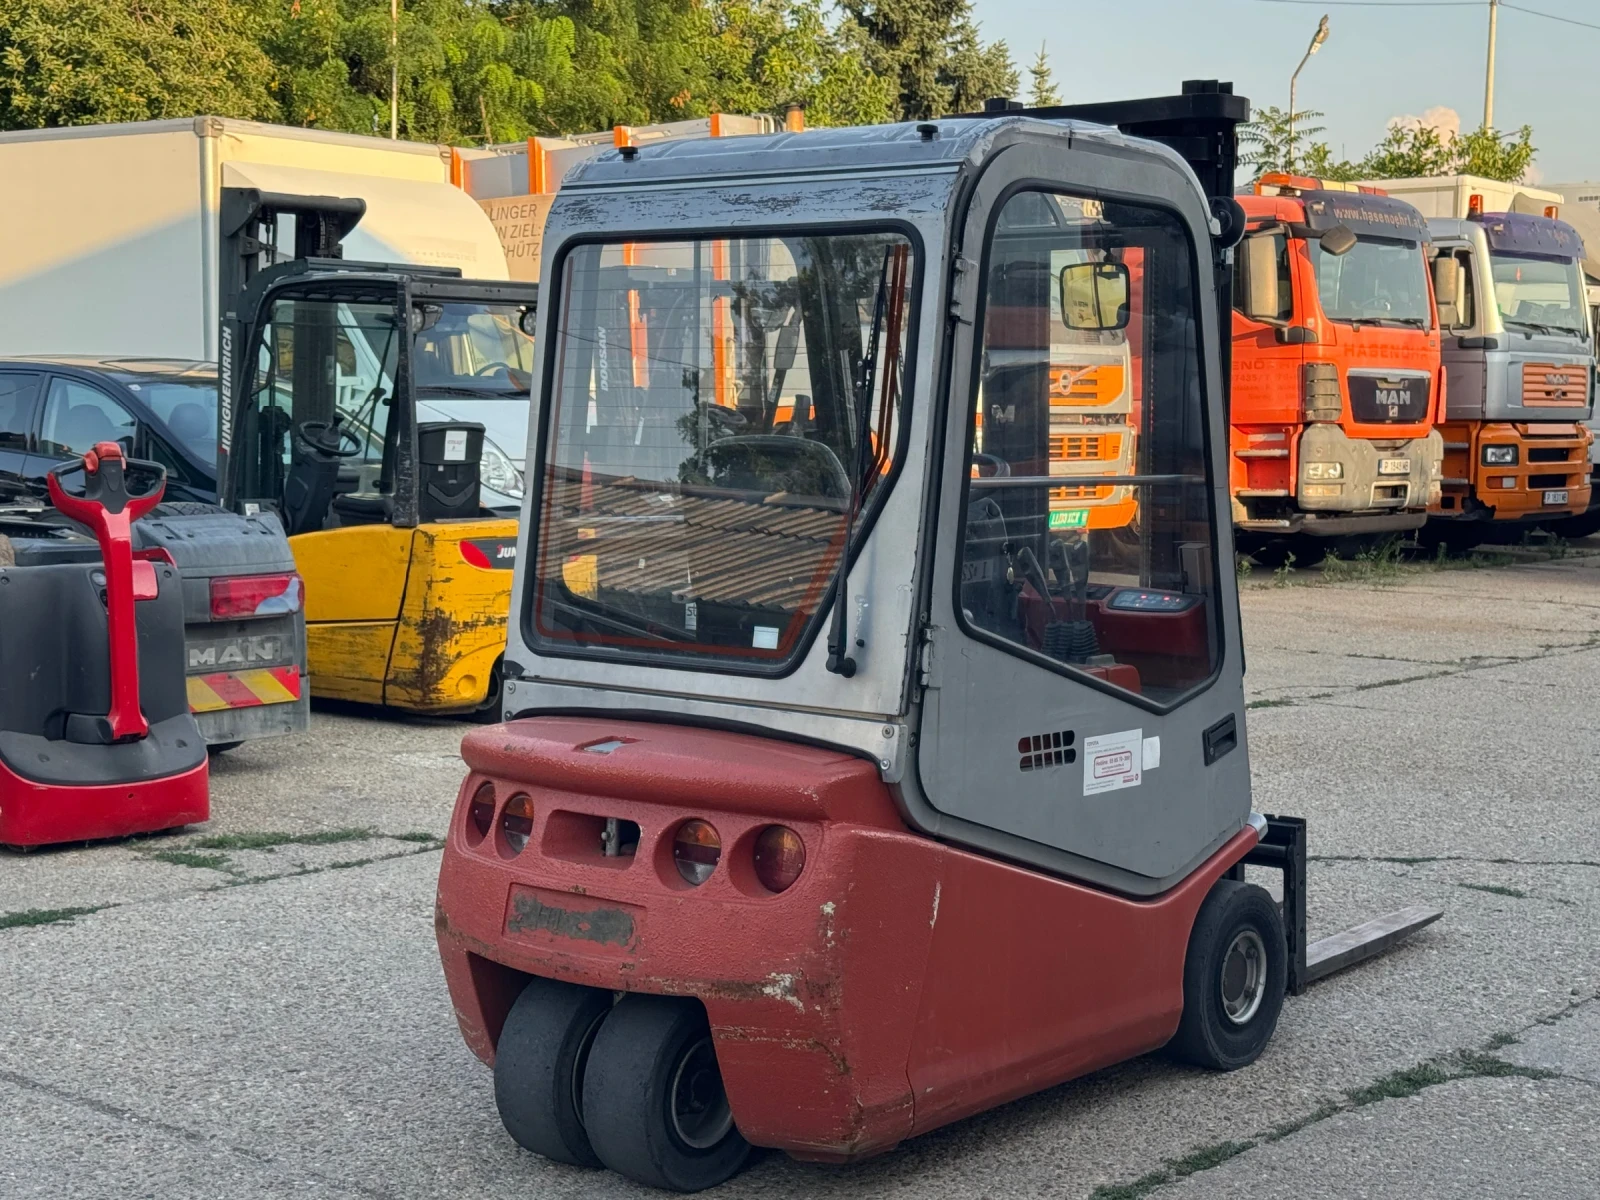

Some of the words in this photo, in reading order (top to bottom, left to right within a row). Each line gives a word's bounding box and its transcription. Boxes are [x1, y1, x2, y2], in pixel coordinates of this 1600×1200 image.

[510, 223, 541, 239] ZIEL:
[597, 326, 609, 392] DOOSAN
[221, 326, 232, 456] JUNGHEINRICH
[1375, 389, 1411, 405] MAN
[189, 643, 274, 667] MAN
